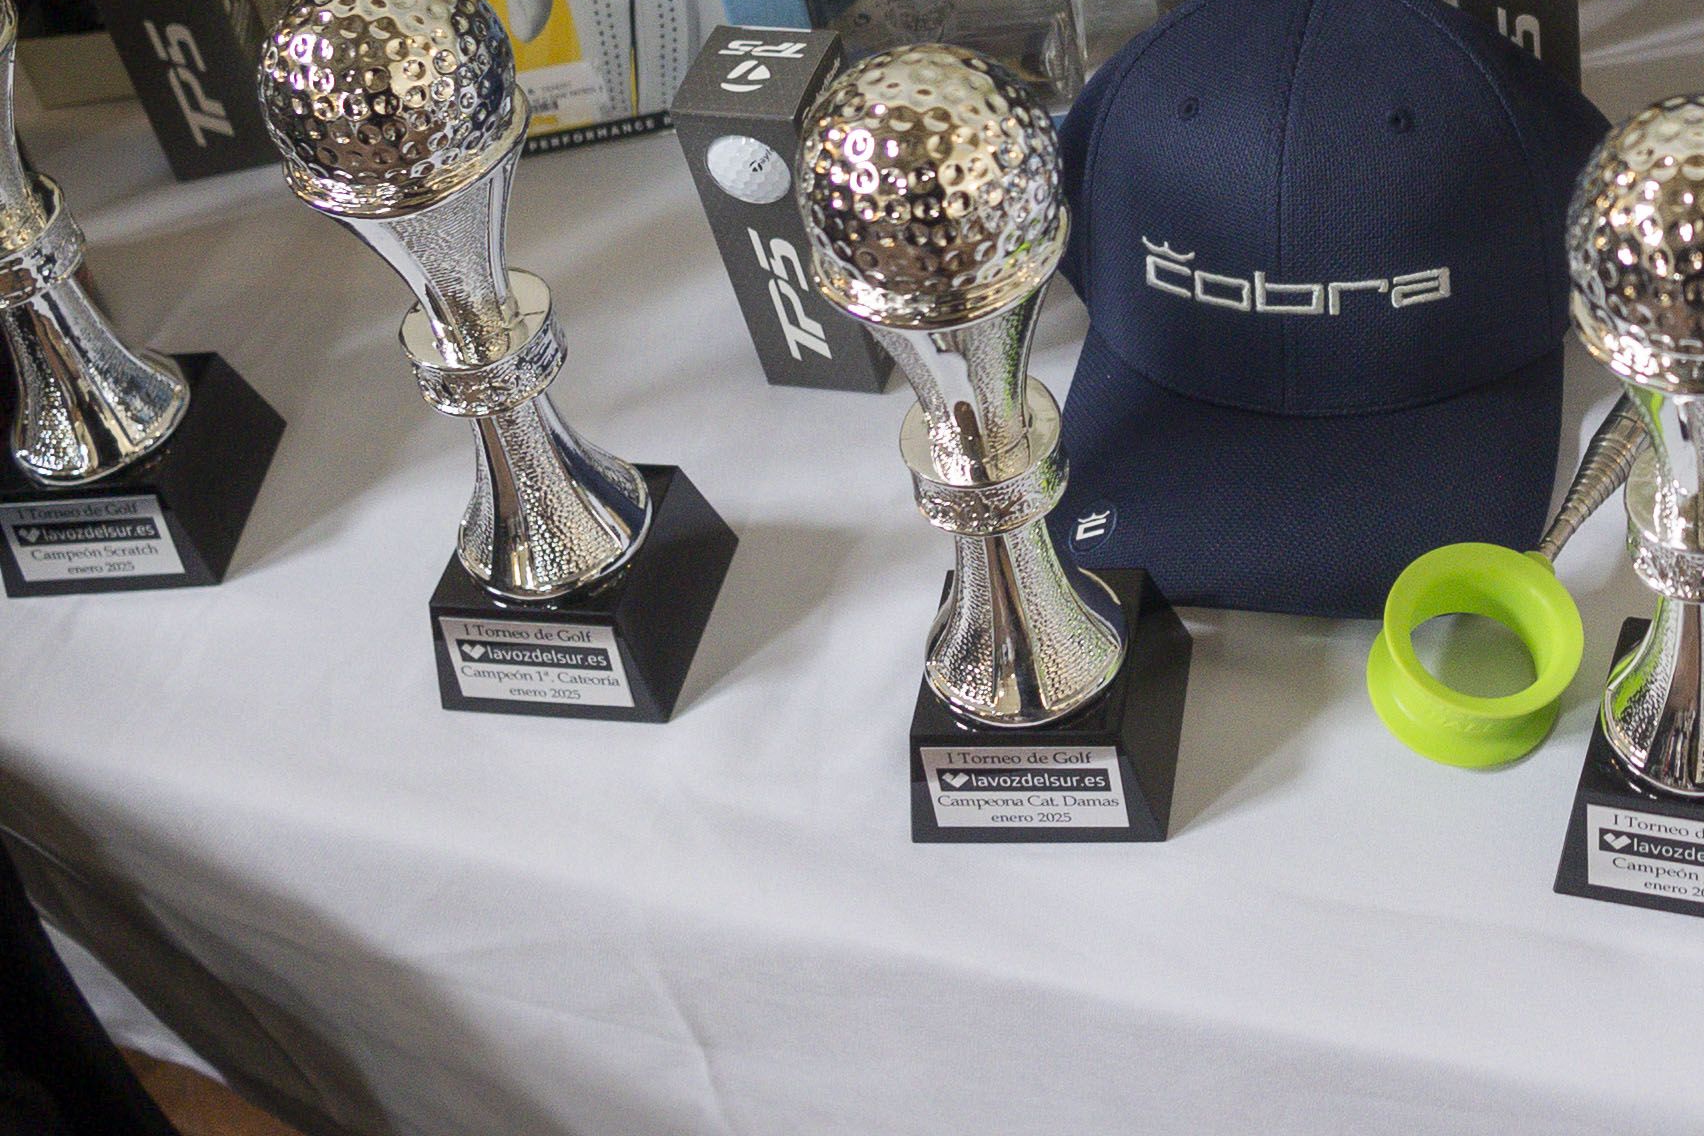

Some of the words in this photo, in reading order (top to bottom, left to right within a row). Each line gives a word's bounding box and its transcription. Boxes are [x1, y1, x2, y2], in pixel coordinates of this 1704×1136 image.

[718, 39, 808, 59] TP5
[144, 19, 235, 148] TP5
[747, 226, 833, 362] TP5
[1145, 254, 1451, 316] cobra
[104, 502, 138, 515] Golf
[43, 522, 156, 542] lavozdelsur.es
[31, 546, 102, 562] Campeón
[104, 544, 159, 557] Scratch
[67, 563, 103, 575] enero
[473, 625, 530, 640] Torneo
[534, 627, 554, 641] de
[557, 629, 592, 643] Golf
[487, 645, 608, 667] lavozdelsur.es
[461, 666, 533, 683] Campeón
[509, 688, 547, 698] enero
[551, 689, 581, 701] 2025
[946, 752, 953, 764] I
[957, 751, 1022, 764] Torneo
[1027, 751, 1049, 764] de
[1052, 751, 1094, 764] Golf
[971, 773, 1106, 788] lavozdelsur.es
[937, 795, 1024, 810] Campeona
[1027, 795, 1059, 807] Cat.
[1062, 796, 1119, 807] Damas
[991, 814, 1034, 823] enero
[1038, 812, 1072, 823] 2025
[1613, 814, 1619, 826] I
[1624, 816, 1690, 838] Torneo
[1612, 856, 1700, 882] Campeón
[1643, 881, 1688, 895] enero
